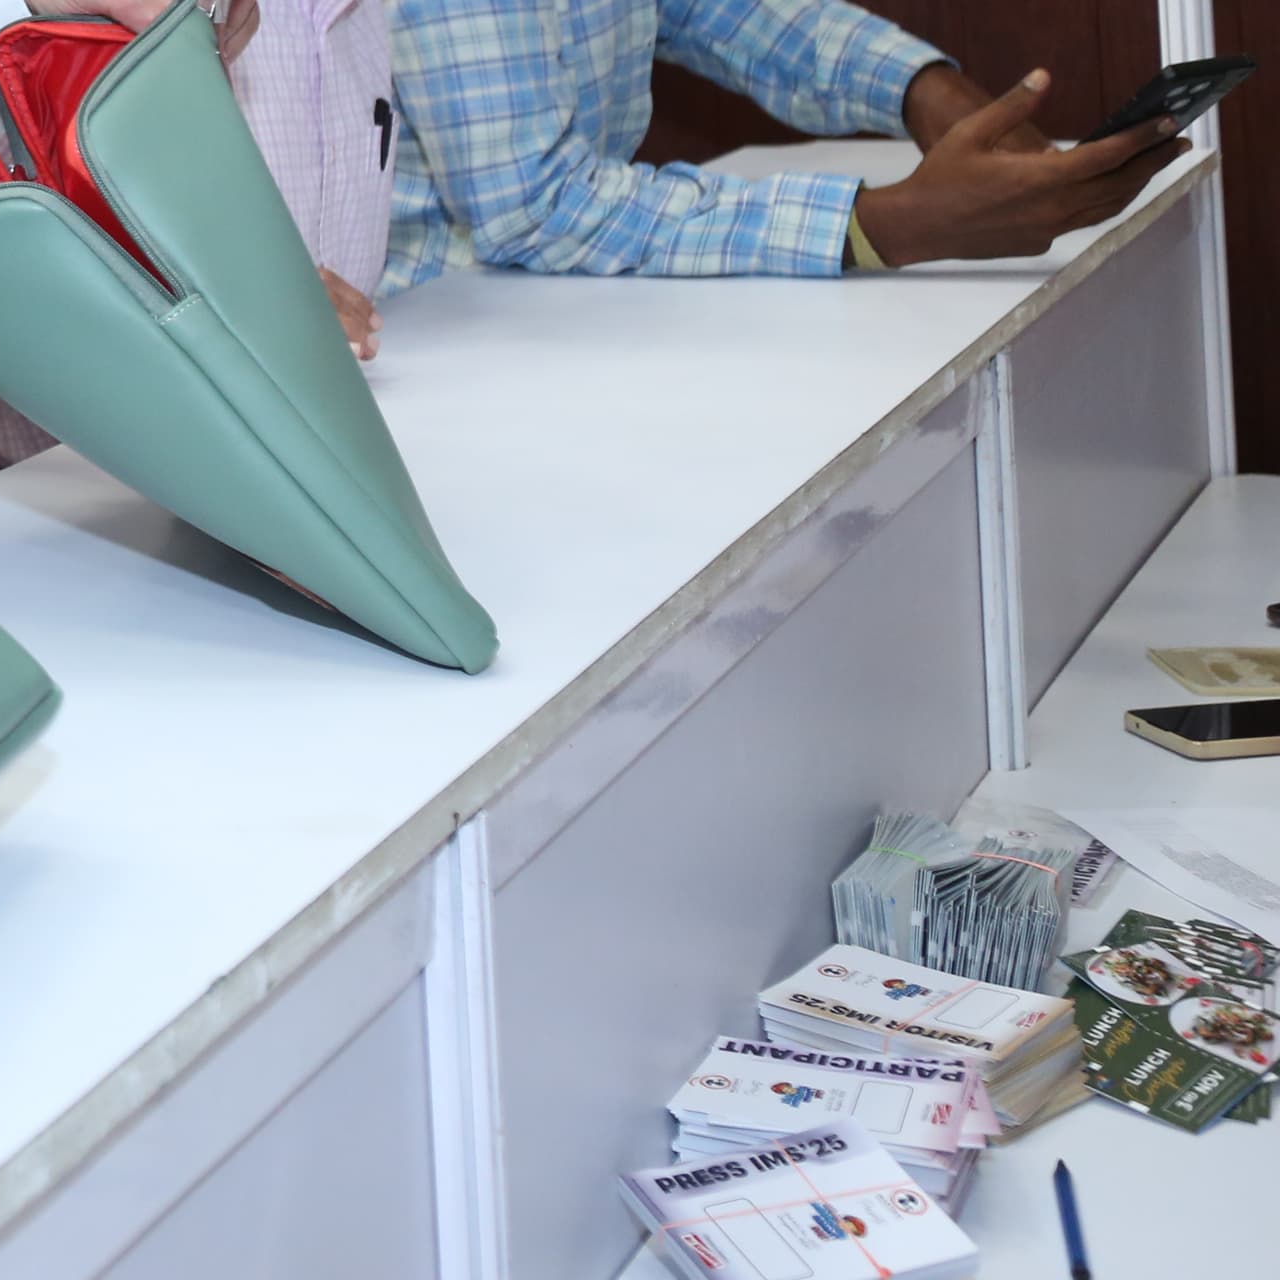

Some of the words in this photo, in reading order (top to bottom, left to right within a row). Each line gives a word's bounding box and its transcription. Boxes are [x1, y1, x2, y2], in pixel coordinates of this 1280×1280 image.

[789, 992, 881, 1026] IMS'25
[1082, 1006, 1124, 1046] LUNCH
[887, 1019, 994, 1052] VISITOR
[718, 1040, 965, 1082] PARTICIPANT
[1123, 1047, 1172, 1086] LUNCH
[1198, 1069, 1226, 1097] NOV
[654, 1160, 748, 1194] PRESS
[750, 1133, 848, 1172] IMS'25
